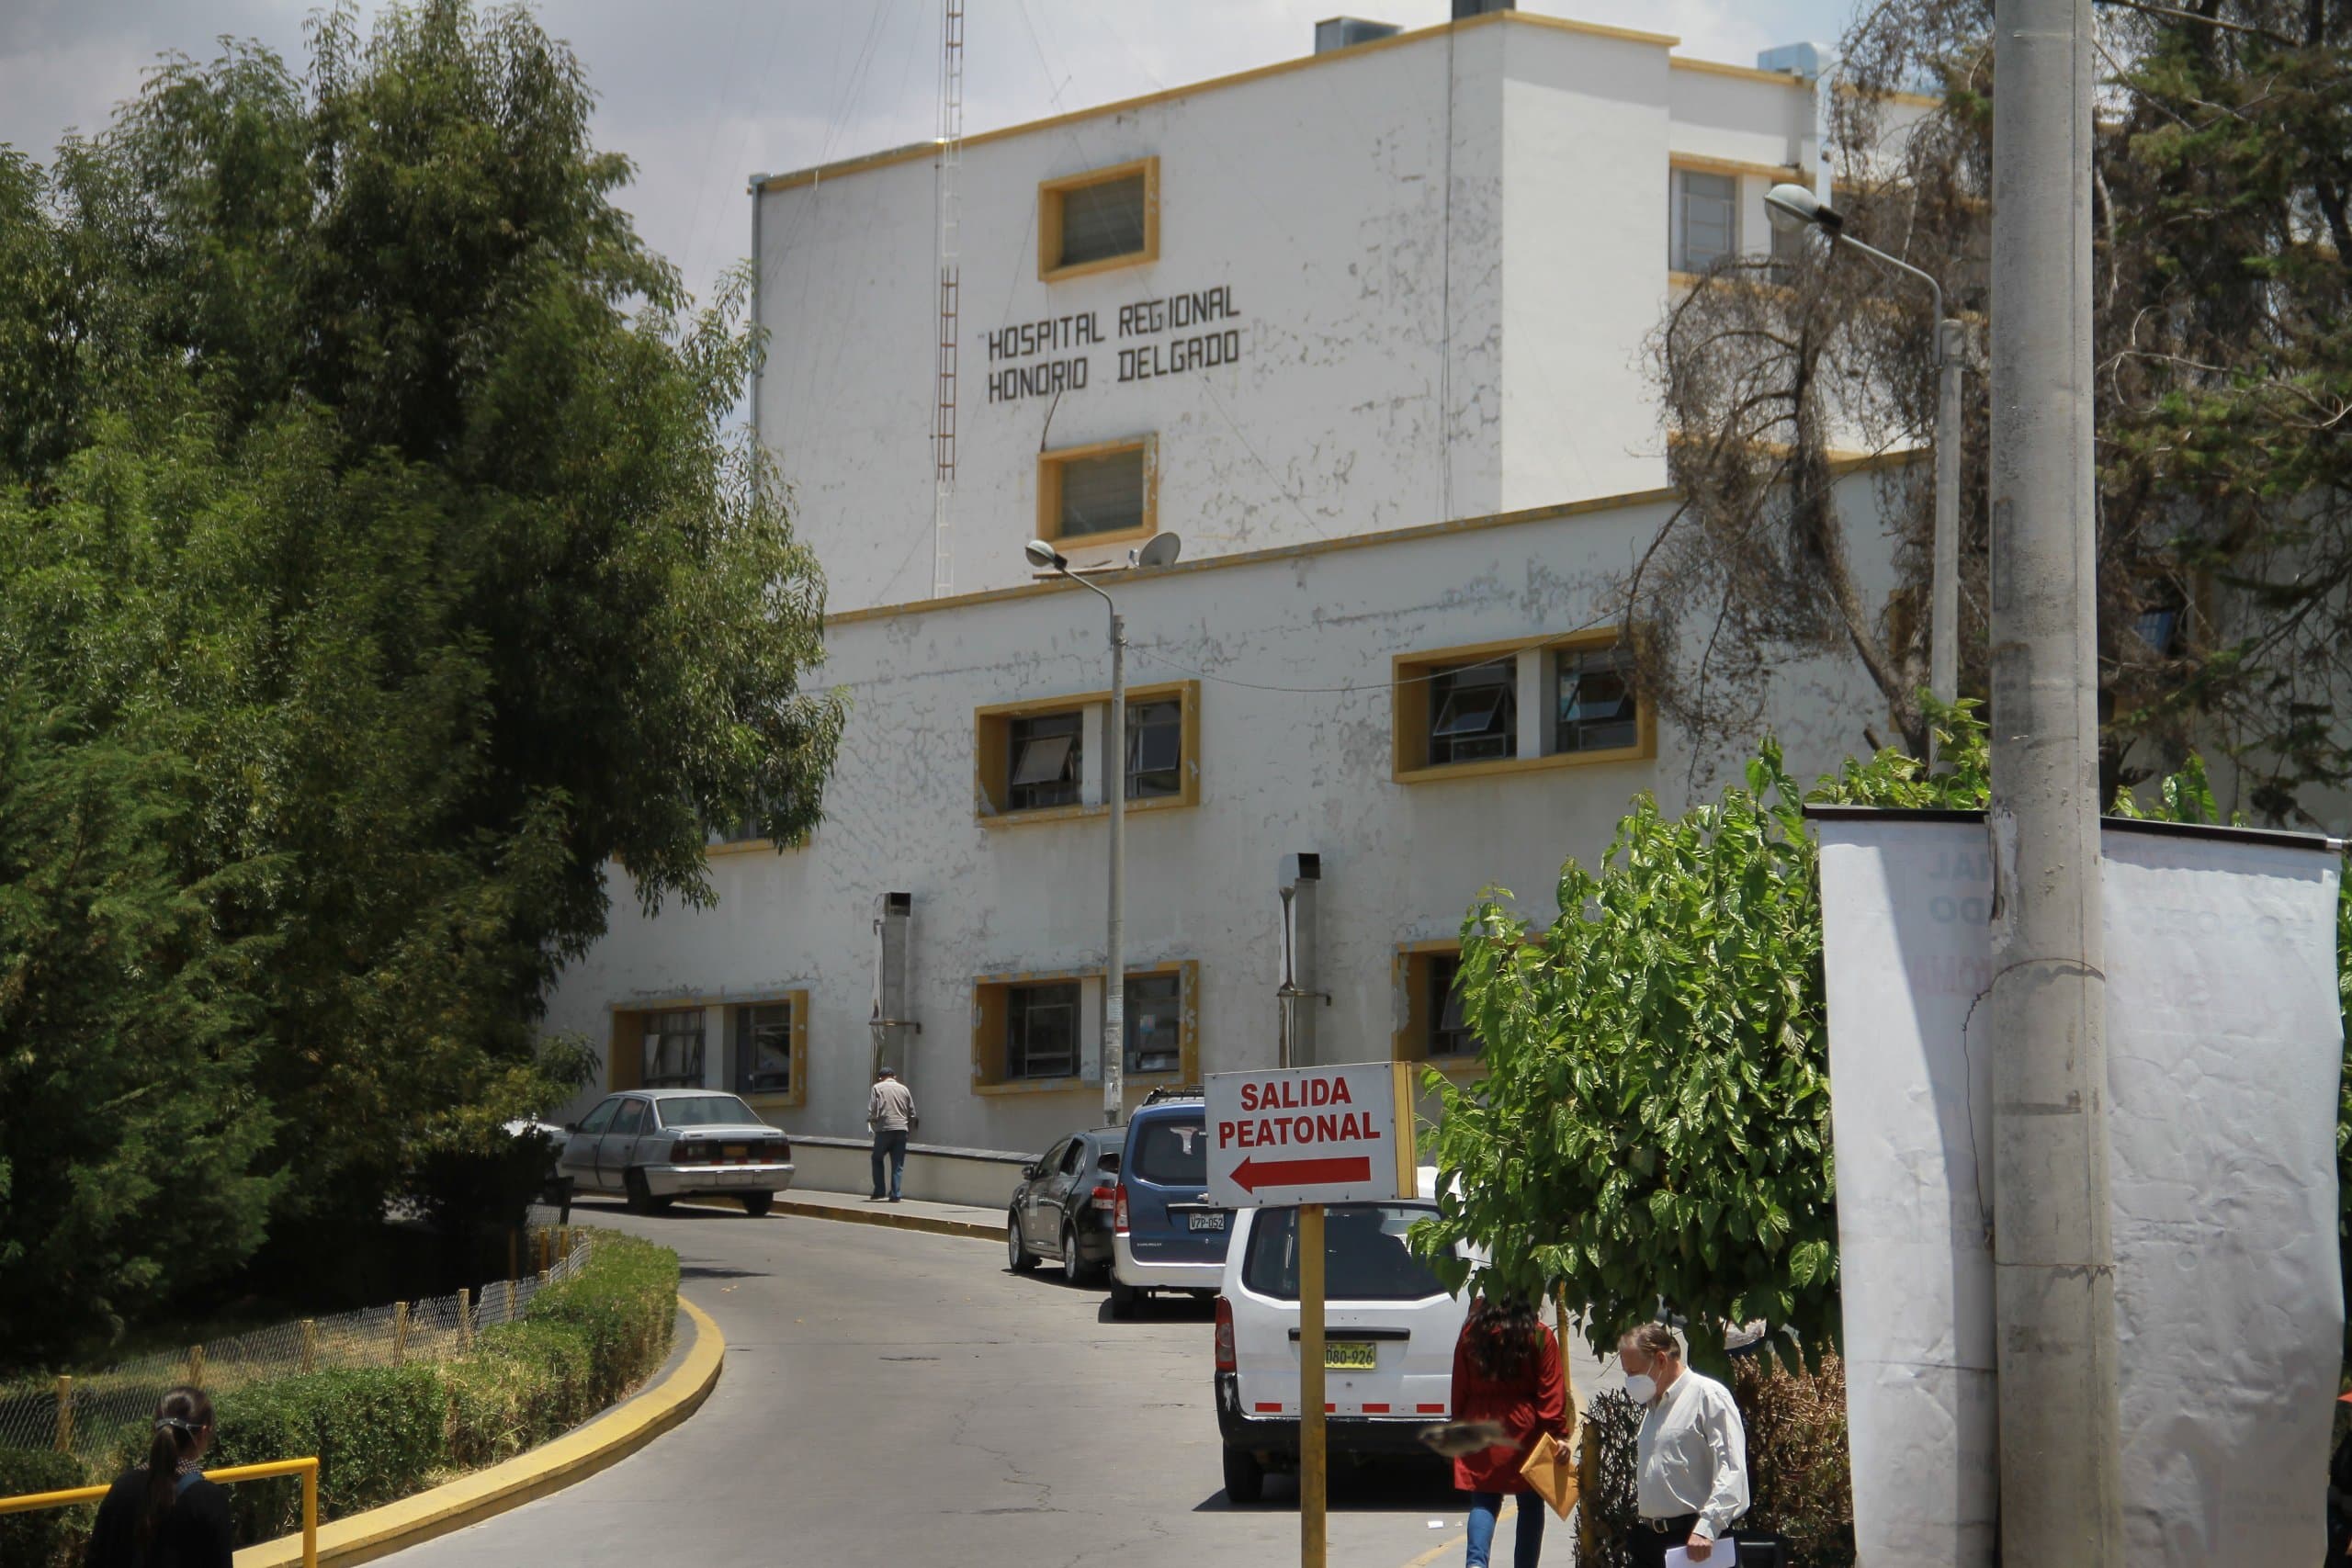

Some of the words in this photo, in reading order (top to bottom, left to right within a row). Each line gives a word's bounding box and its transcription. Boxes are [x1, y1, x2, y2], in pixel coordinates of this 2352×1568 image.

[989, 311, 1105, 361] HOSPITAL
[1118, 285, 1240, 338] REGIONAL
[989, 356, 1088, 404] HONORIO
[1117, 329, 1239, 383] DELGADO
[1240, 1077, 1351, 1111] SALIDA
[1219, 1111, 1381, 1149] PEATONAL
[1191, 1215, 1224, 1228] V7P-052
